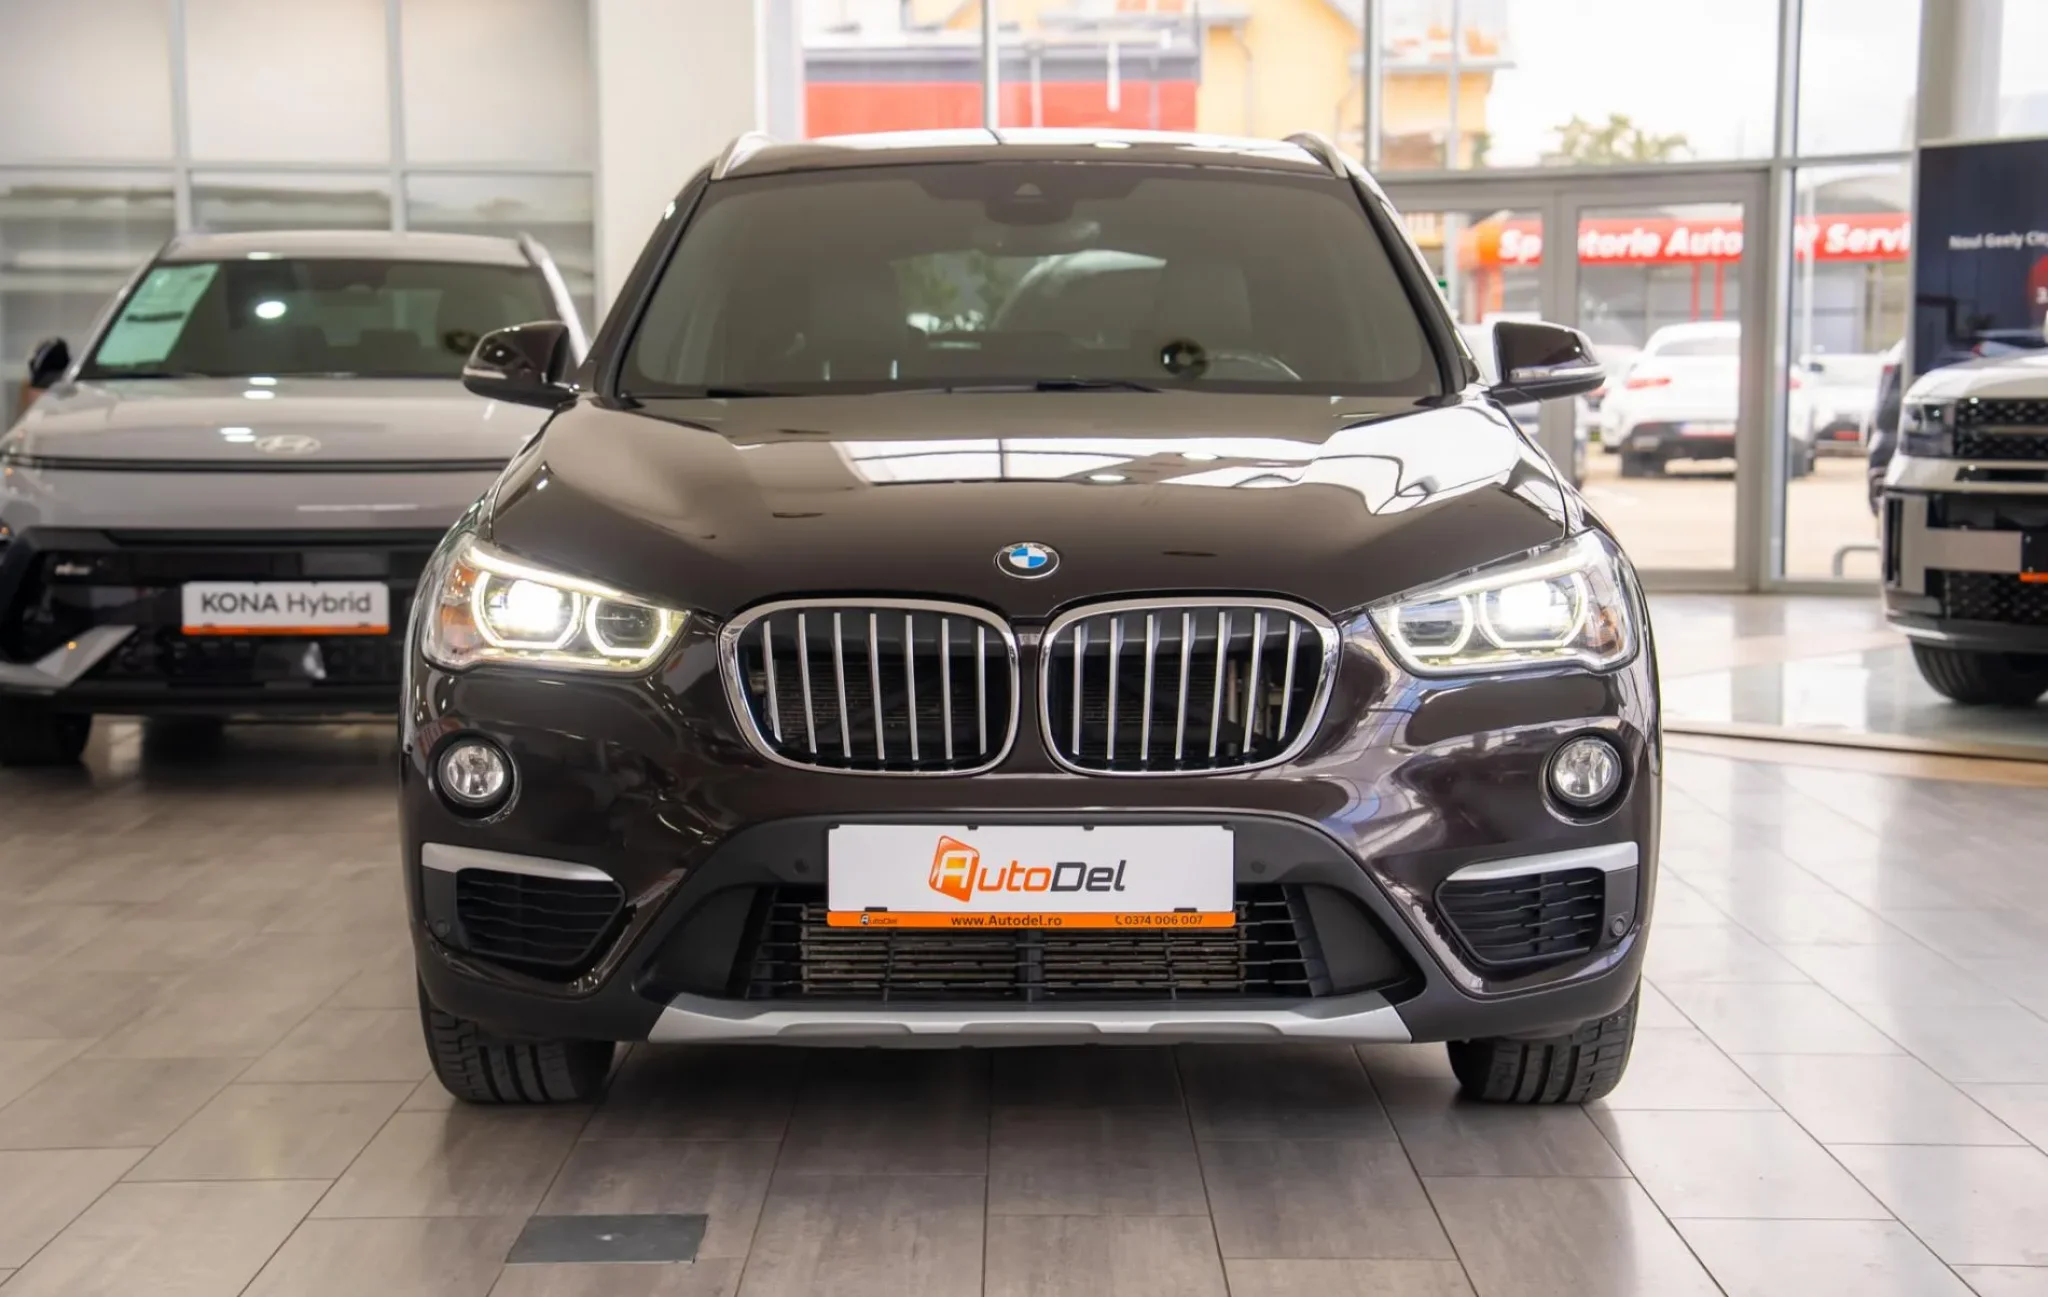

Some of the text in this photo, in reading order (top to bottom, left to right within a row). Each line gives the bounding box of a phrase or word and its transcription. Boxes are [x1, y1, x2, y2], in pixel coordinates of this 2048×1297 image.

[1665, 227, 1743, 256] Auto
[202, 591, 371, 618] KONA Hybrid
[935, 851, 1127, 893] AutoDel
[951, 915, 1062, 926] www.Autodel.ro
[1125, 915, 1151, 925] 0374
[1155, 915, 1178, 925] 006
[1181, 915, 1203, 925] 007
